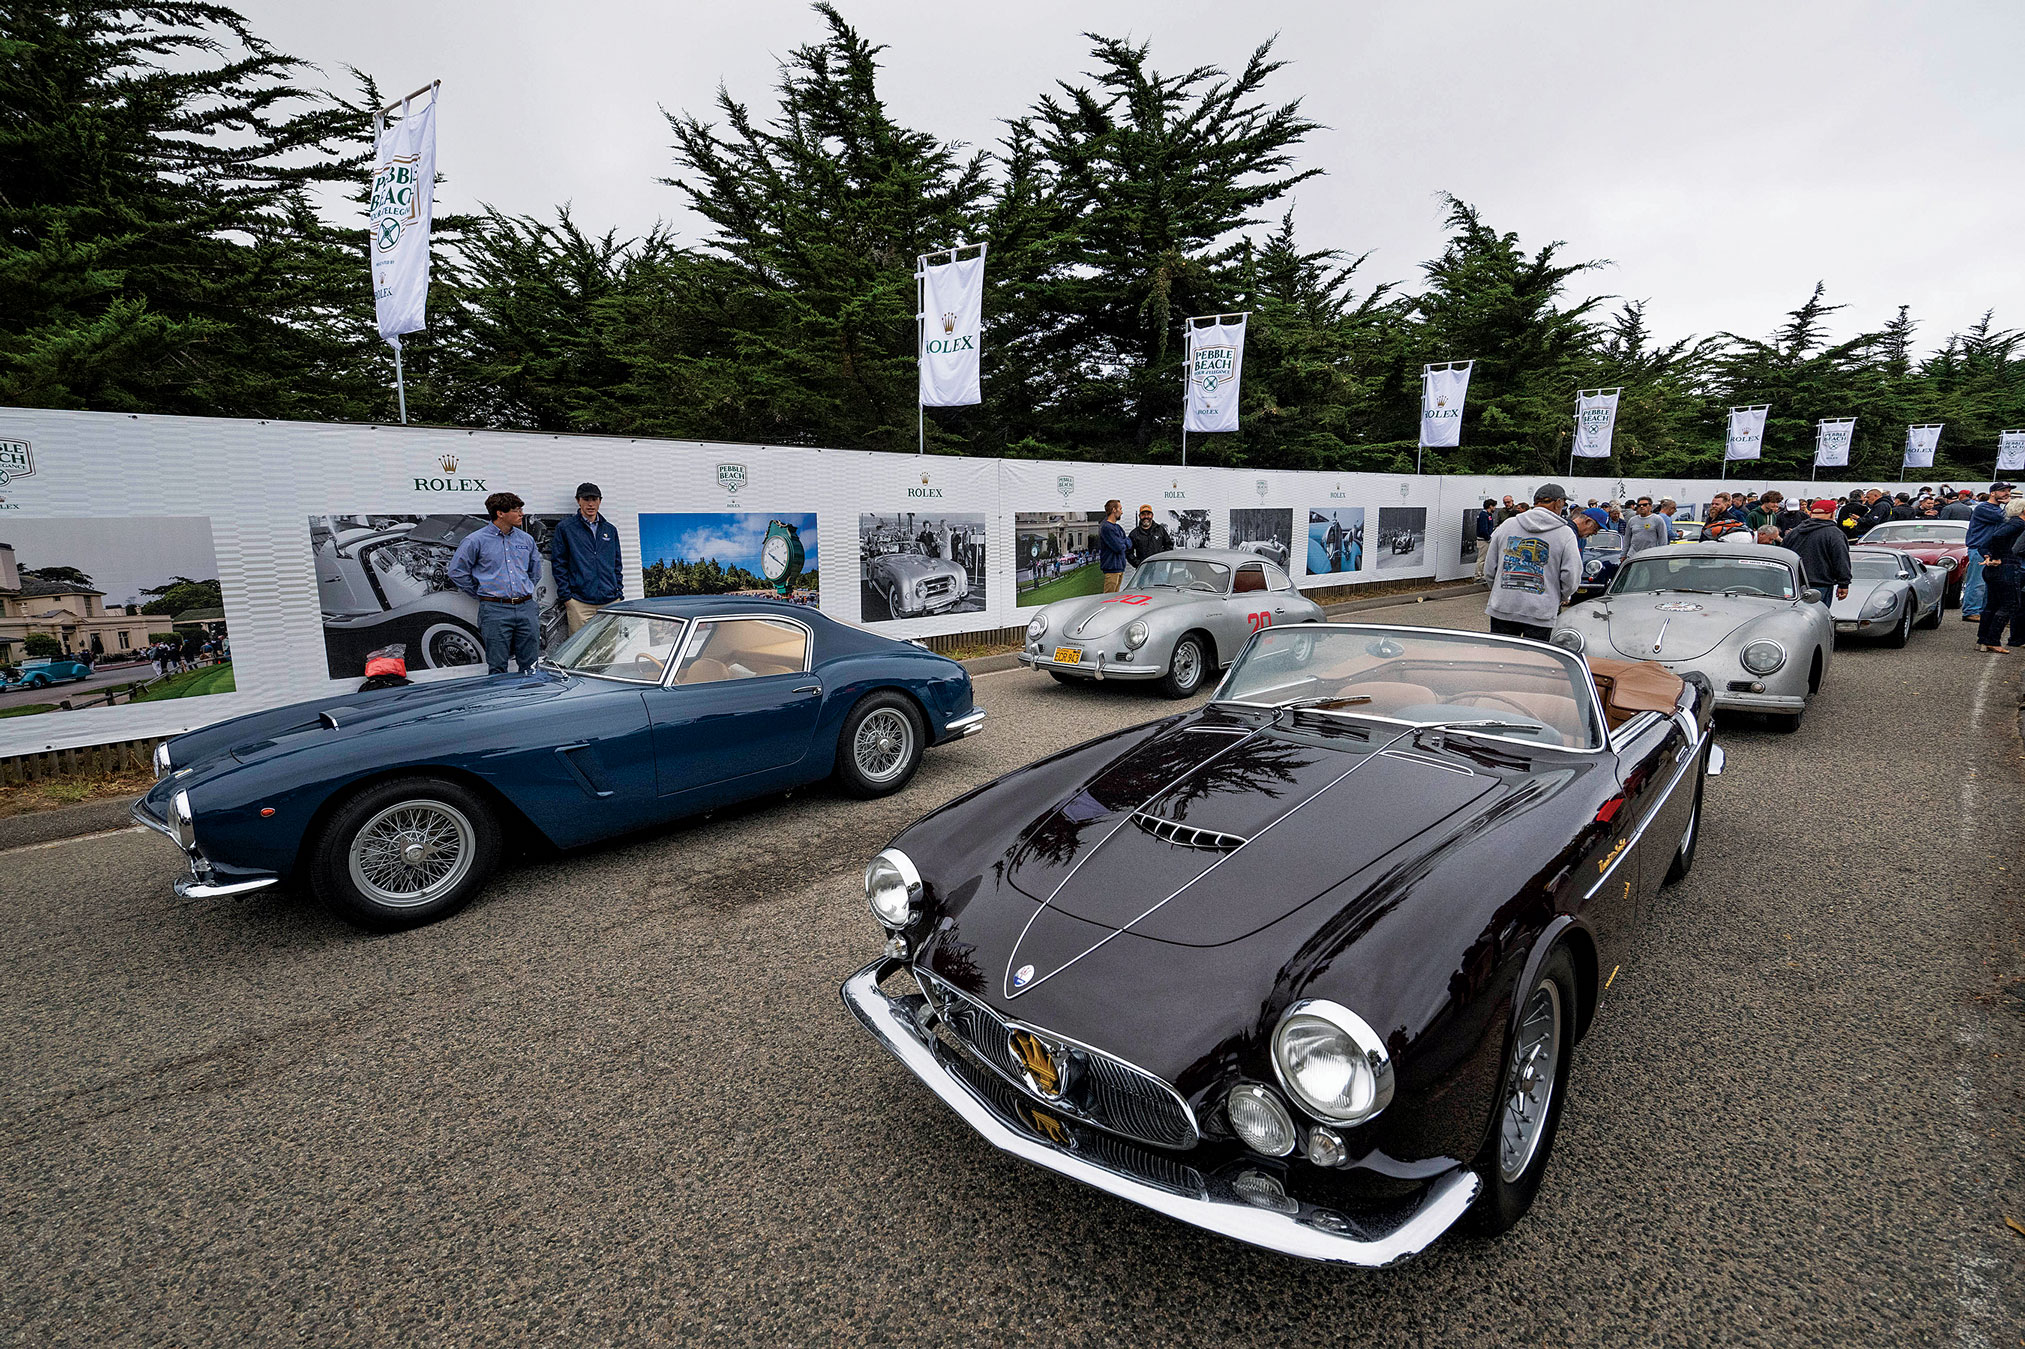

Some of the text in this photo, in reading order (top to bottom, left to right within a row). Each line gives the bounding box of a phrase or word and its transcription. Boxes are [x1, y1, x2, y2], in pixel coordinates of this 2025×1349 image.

[1195, 350, 1233, 361] PEBBLE
[1194, 359, 1232, 371] BEACH
[719, 472, 745, 480] BEACH
[414, 478, 488, 492] ROLEX
[907, 488, 943, 498] ROLEX
[1100, 594, 1153, 606] 20
